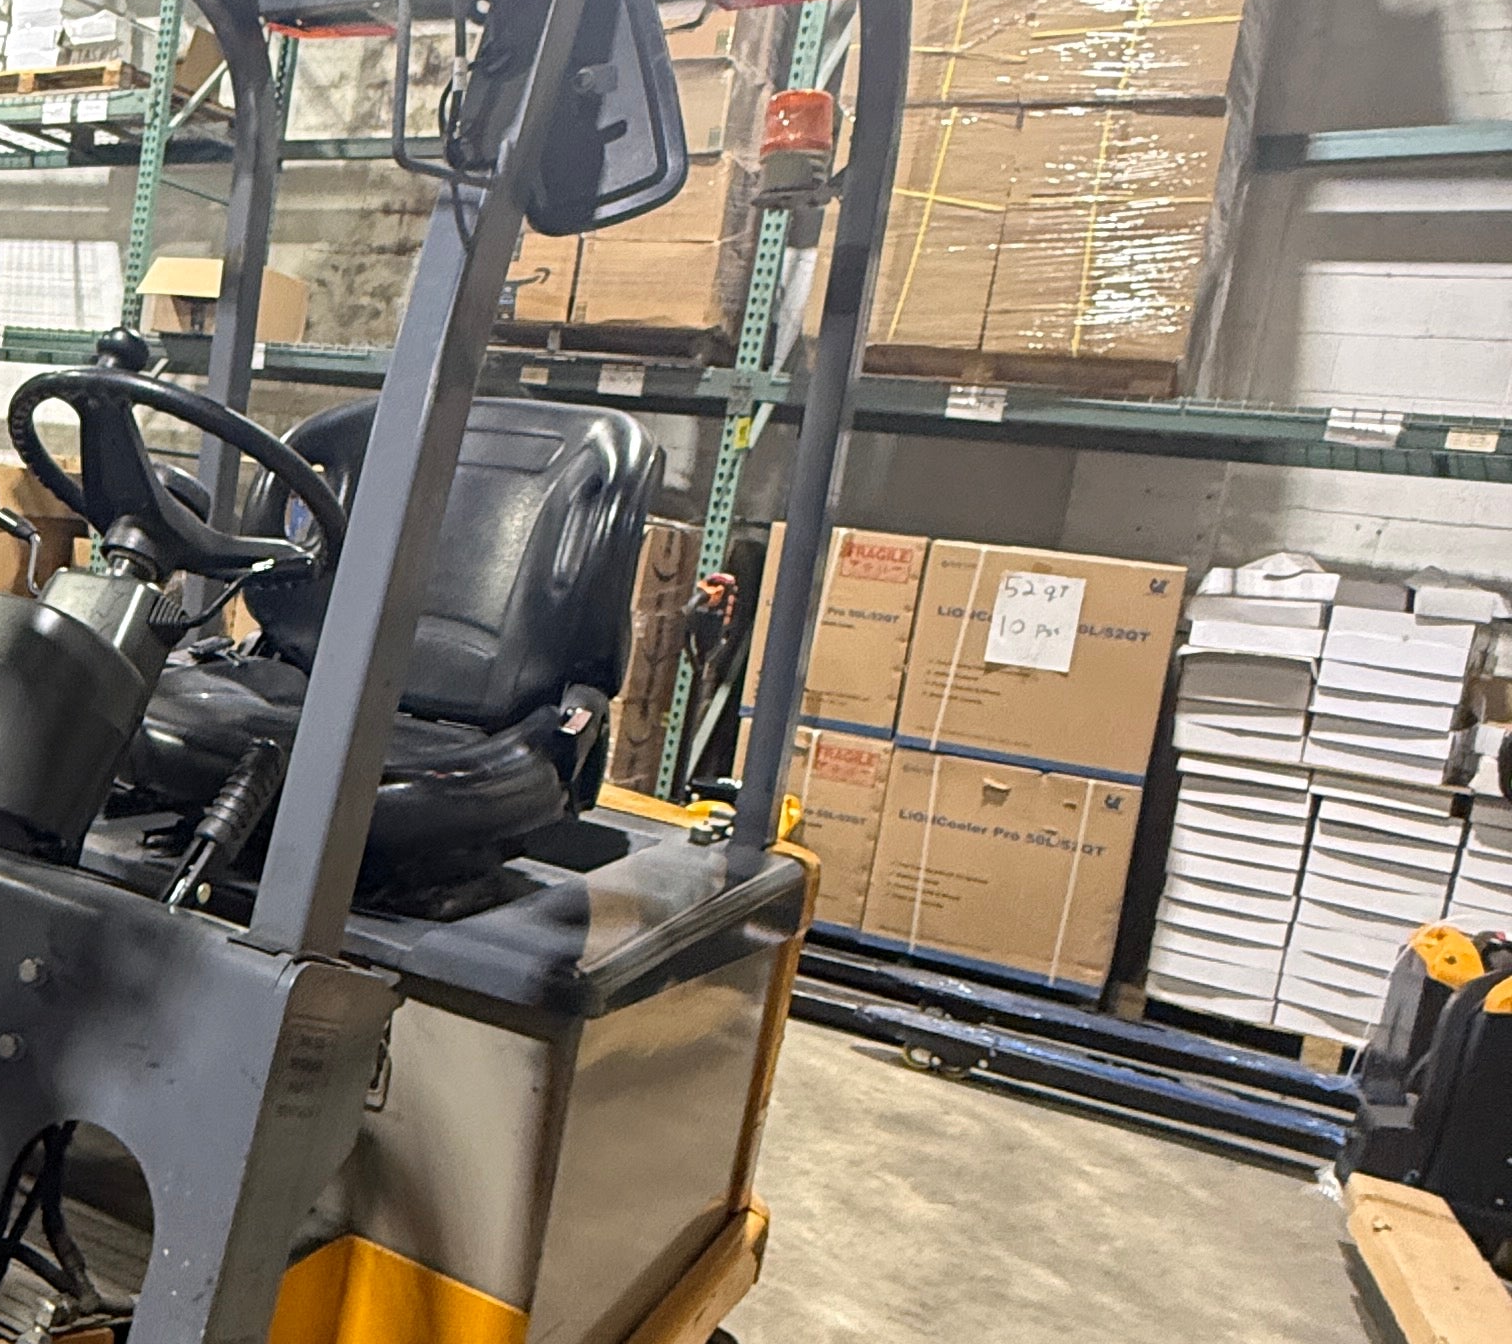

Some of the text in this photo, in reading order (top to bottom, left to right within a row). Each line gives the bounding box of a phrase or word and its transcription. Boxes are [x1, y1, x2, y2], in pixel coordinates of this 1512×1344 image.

[1004, 575, 1036, 598] 52
[999, 615, 1026, 637] 10
[993, 826, 1021, 841] Pro
